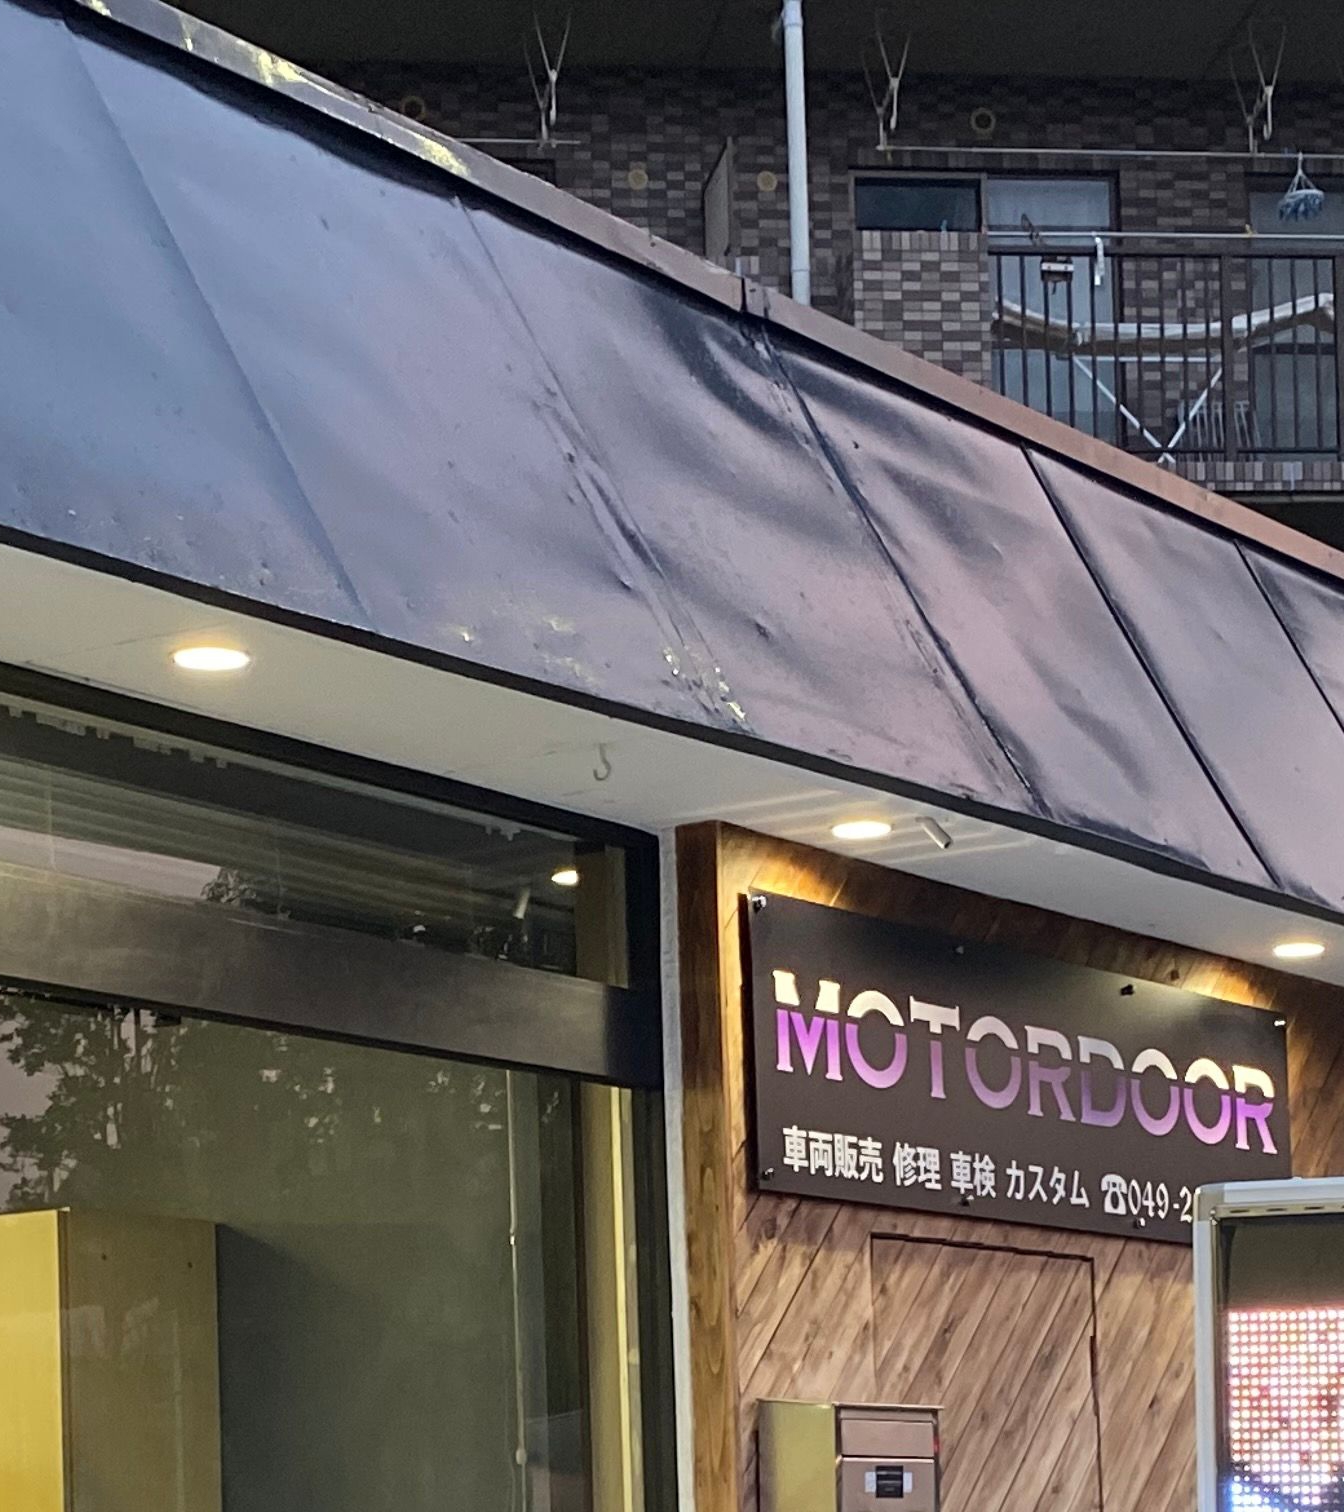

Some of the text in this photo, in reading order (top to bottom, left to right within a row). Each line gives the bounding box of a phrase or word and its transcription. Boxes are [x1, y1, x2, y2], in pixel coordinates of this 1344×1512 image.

[772, 969, 1278, 1155] MOTORDOOR
[782, 1124, 884, 1183] 車両販売
[892, 1141, 943, 1190] 修理
[949, 1150, 997, 1198] 車検
[1005, 1159, 1091, 1208] カスタム
